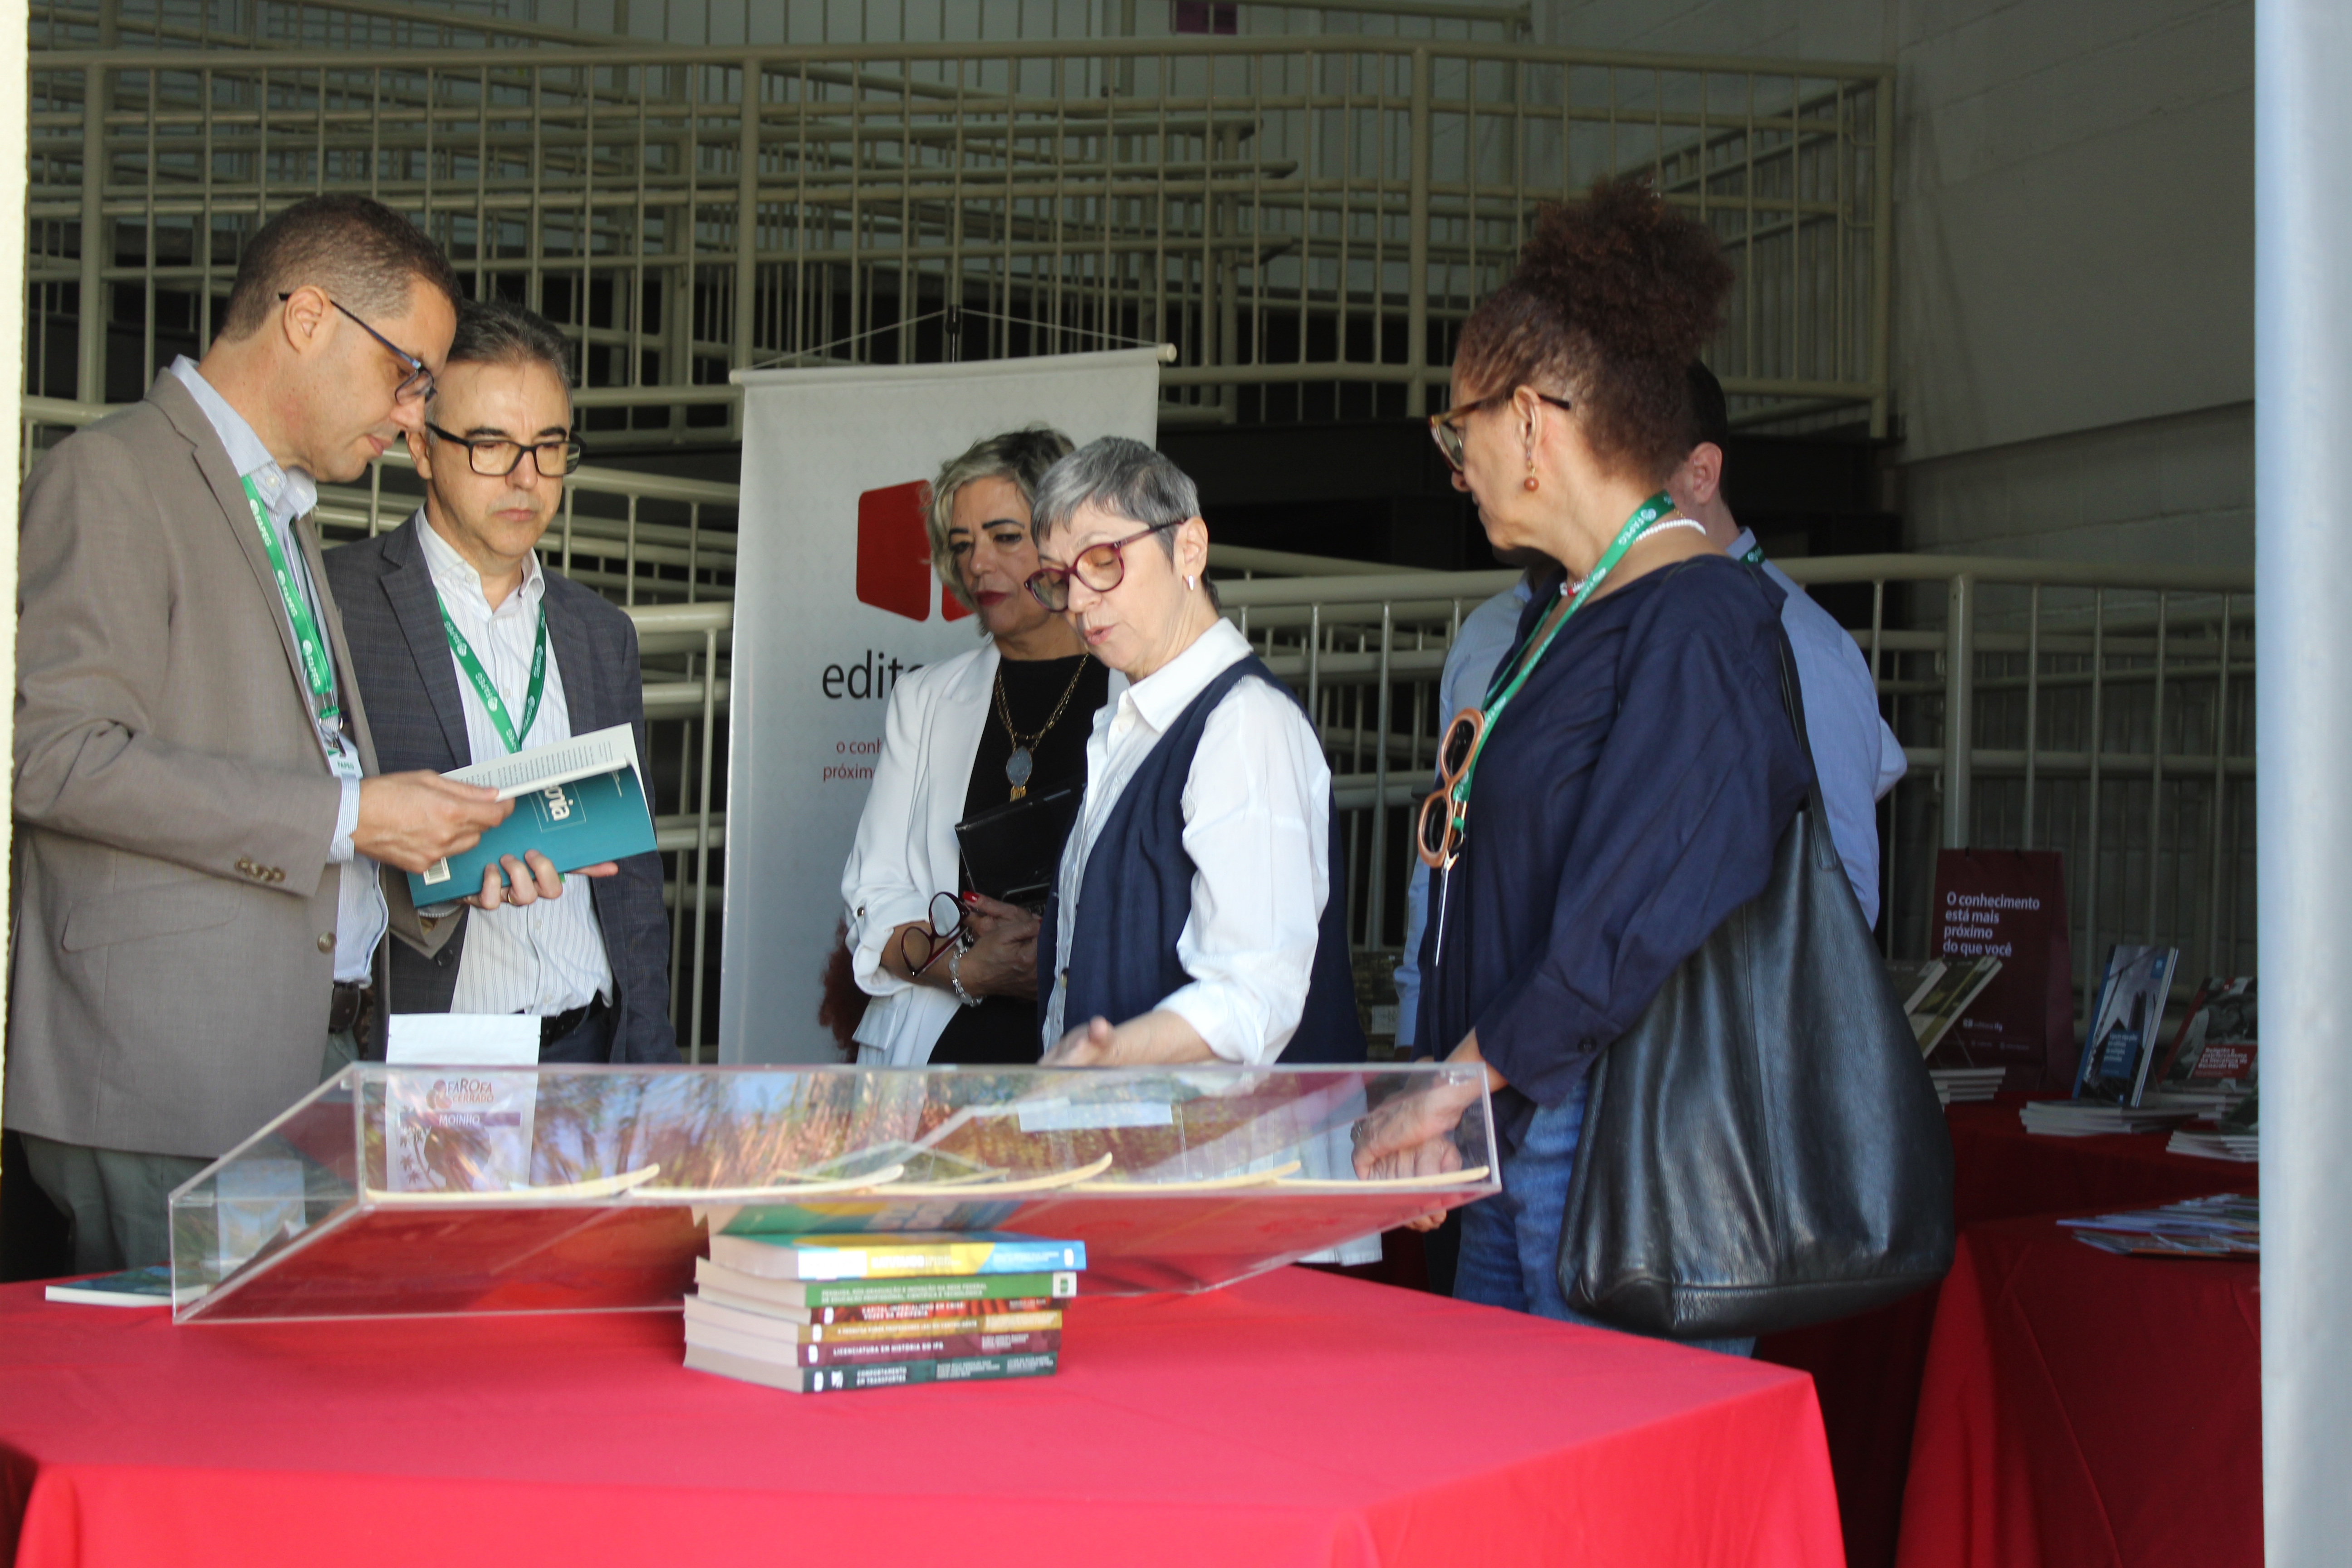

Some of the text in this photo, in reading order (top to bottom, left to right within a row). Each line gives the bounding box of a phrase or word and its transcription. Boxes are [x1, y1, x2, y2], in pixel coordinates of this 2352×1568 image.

[255, 515, 271, 547] FAPEG
[1618, 517, 1644, 546] FAPEG
[282, 585, 298, 617] FAPEG
[822, 648, 924, 700] edit
[475, 672, 493, 700] FAPEG
[837, 740, 846, 754] o
[823, 762, 875, 783] próxim
[1947, 891, 2040, 911] O conhecimento
[1945, 907, 1999, 924] está mais
[1944, 922, 1993, 940] próximo
[1943, 938, 2012, 957] do que você
[448, 1077, 493, 1094] FAROFA
[453, 1093, 495, 1104] CERRADO
[439, 1113, 480, 1127] MOINHO
[833, 1345, 879, 1357] LICENCIATURA
[880, 1344, 890, 1353] EM
[921, 1341, 931, 1352] DO
[856, 1373, 906, 1387] EM TRANSPORTES
[857, 1366, 907, 1379] COMPORTAMENTO
